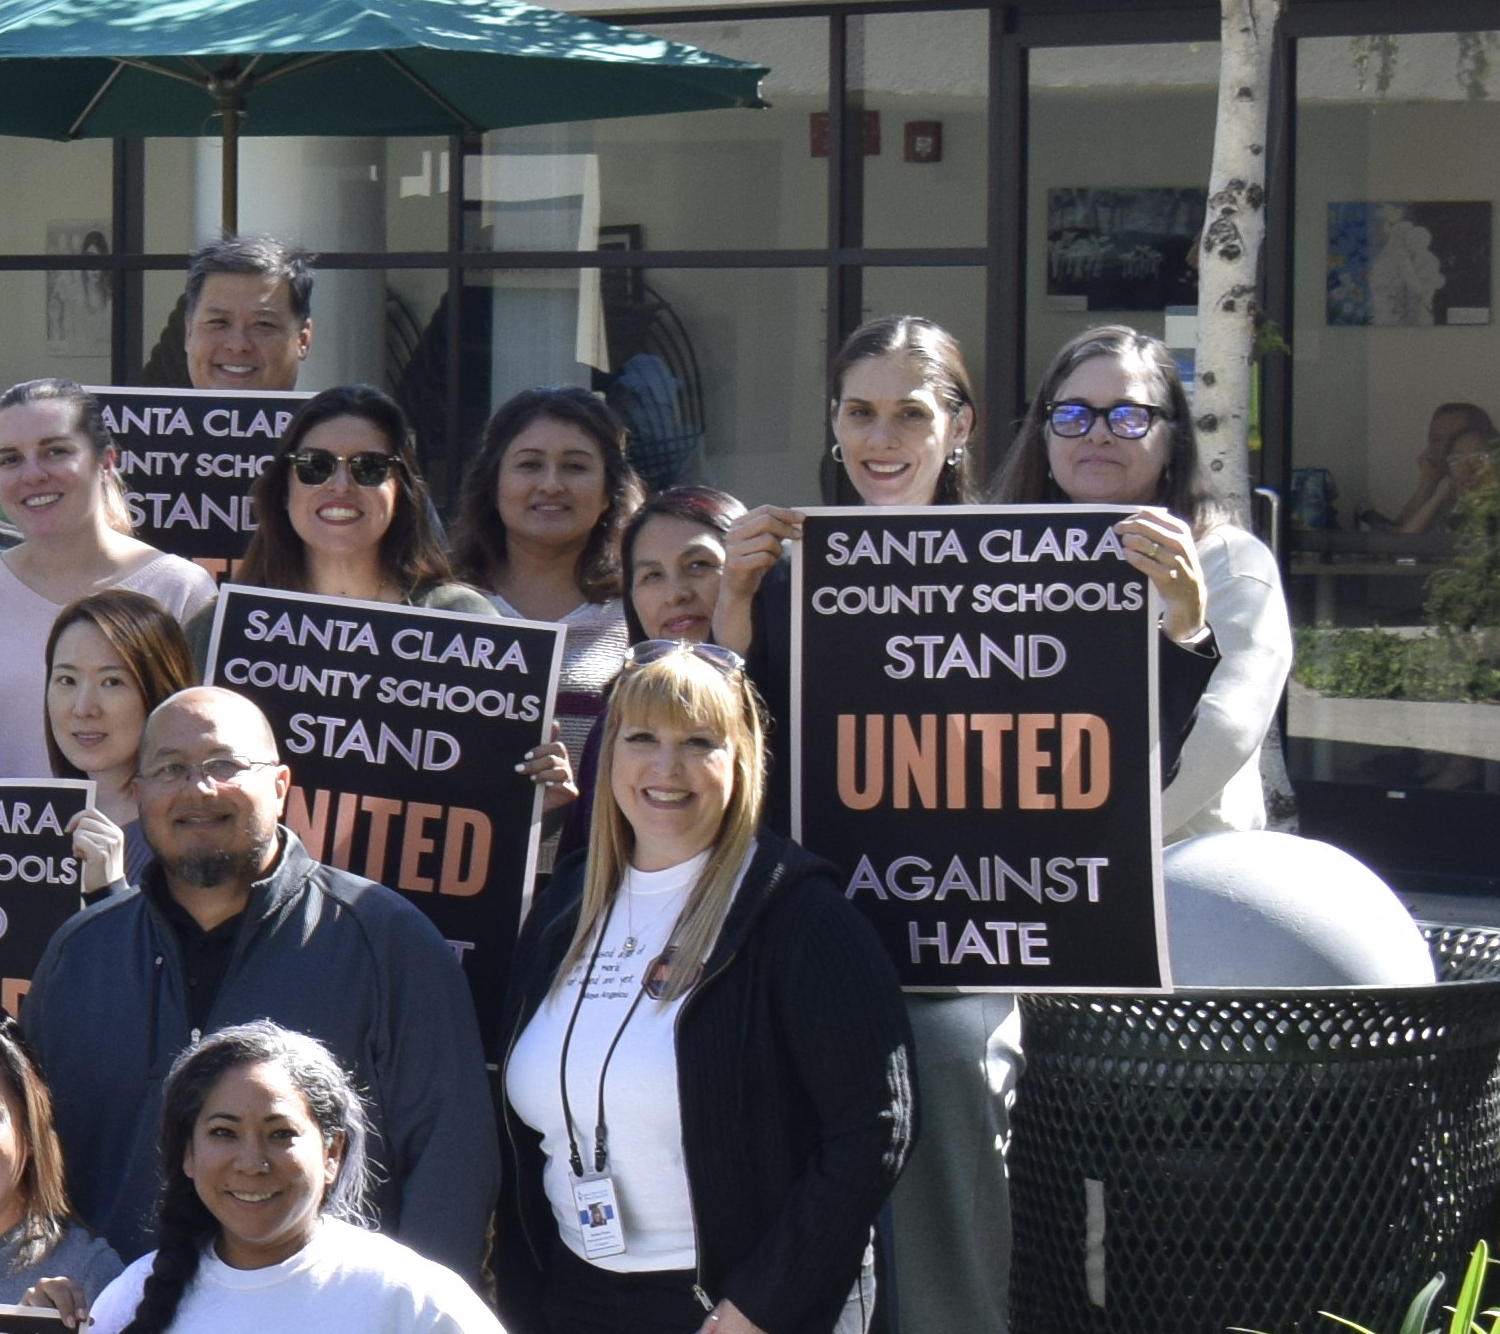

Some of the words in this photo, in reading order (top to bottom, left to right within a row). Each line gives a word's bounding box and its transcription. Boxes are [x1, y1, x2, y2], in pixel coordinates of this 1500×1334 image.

[101, 405, 193, 435] ANTA
[826, 529, 968, 566] SANTA
[979, 527, 1126, 563] CLARA
[812, 584, 963, 615] COUNTY
[972, 582, 1143, 612] SCHOOLS
[244, 609, 379, 656] SANTA
[391, 628, 527, 673] CLARA
[884, 633, 1066, 680] STAND
[224, 658, 372, 700] COUNTY
[376, 675, 541, 722] SCHOOLS
[285, 713, 460, 771] STAND
[837, 713, 1110, 810] UNITED
[285, 785, 492, 897] NITED
[844, 854, 1108, 904] AGAINST
[909, 920, 1050, 966] HATE
